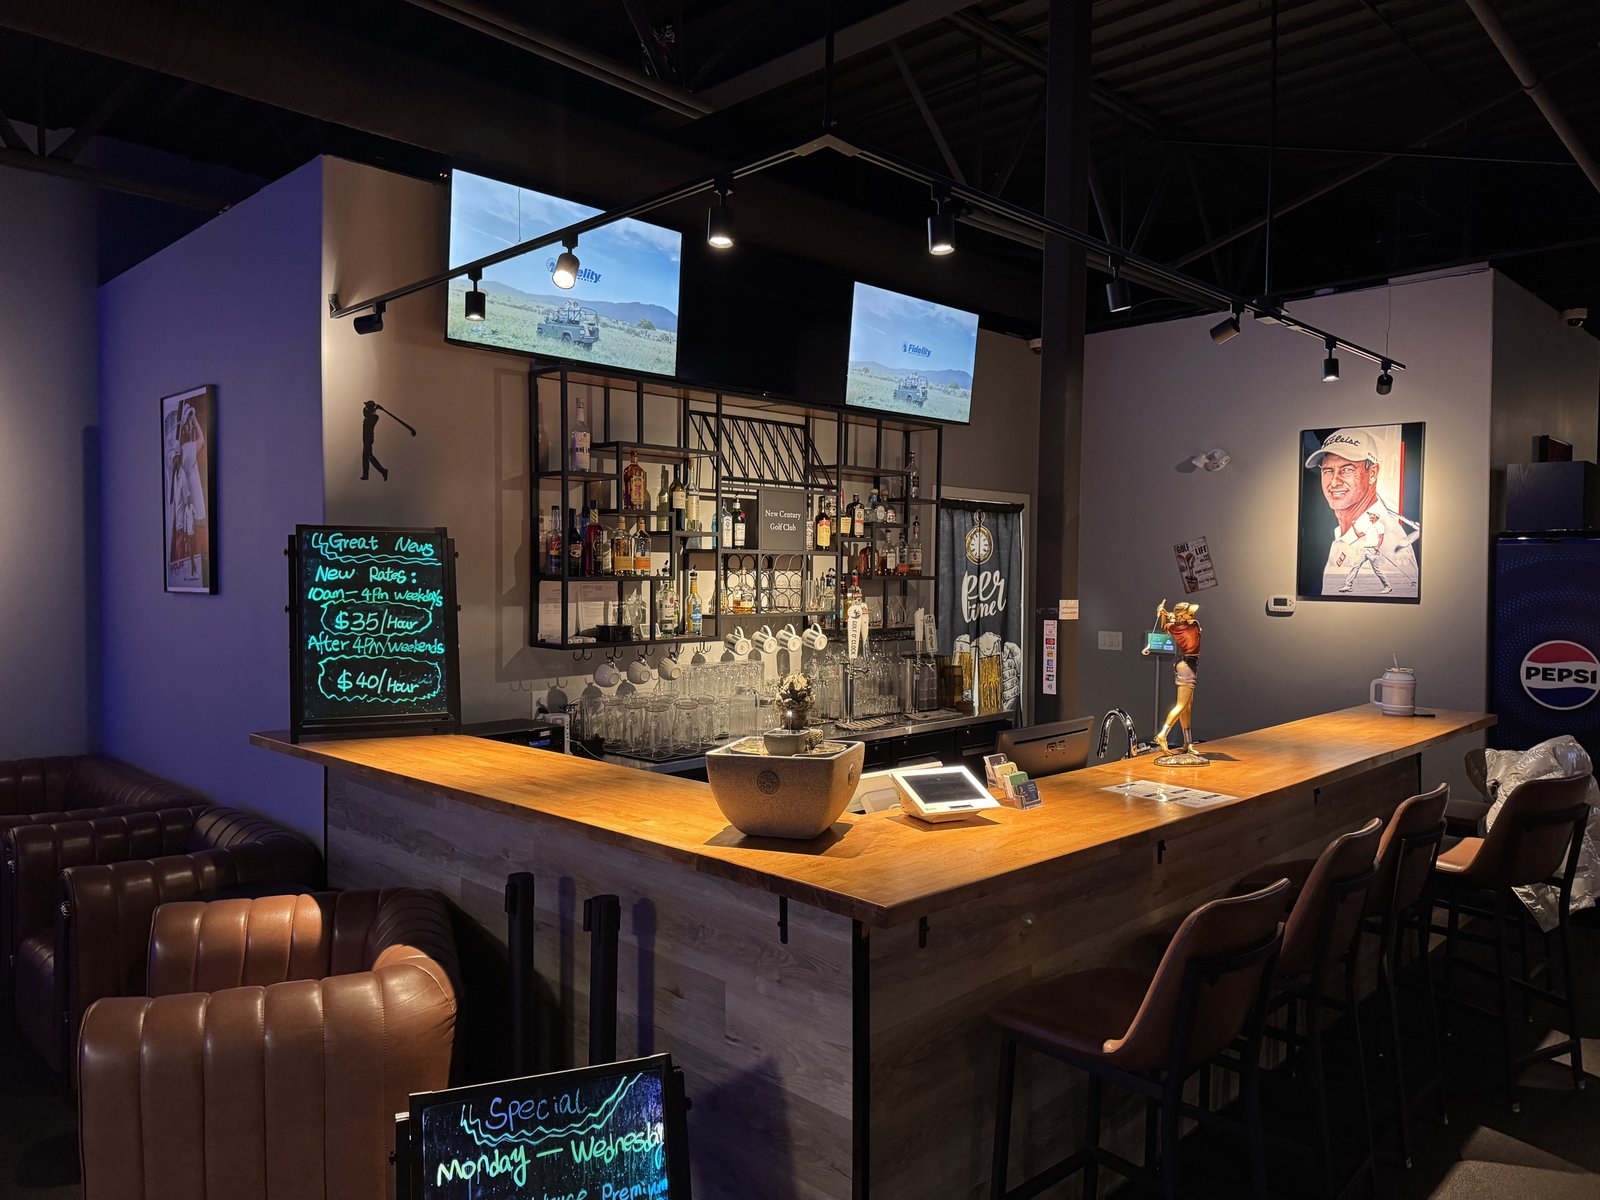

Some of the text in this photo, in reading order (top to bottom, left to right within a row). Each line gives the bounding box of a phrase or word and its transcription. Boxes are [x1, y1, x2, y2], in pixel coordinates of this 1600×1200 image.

[908, 344, 932, 358] Fidelity
[765, 509, 802, 521] New Century
[770, 523, 797, 532] Golf Club
[329, 533, 434, 557] Great News
[1176, 543, 1190, 554] GOLF
[1195, 545, 1208, 556] LIFE
[315, 565, 417, 584] New Rates:
[394, 588, 443, 610] weekdays
[335, 609, 418, 634] $35/Hour
[308, 631, 350, 654] After
[337, 669, 419, 694] $40/Hour
[1525, 666, 1598, 684] PEPSI
[485, 1088, 588, 1131] Special
[437, 1145, 531, 1187] Monday
[570, 1122, 665, 1169] Wednesday
